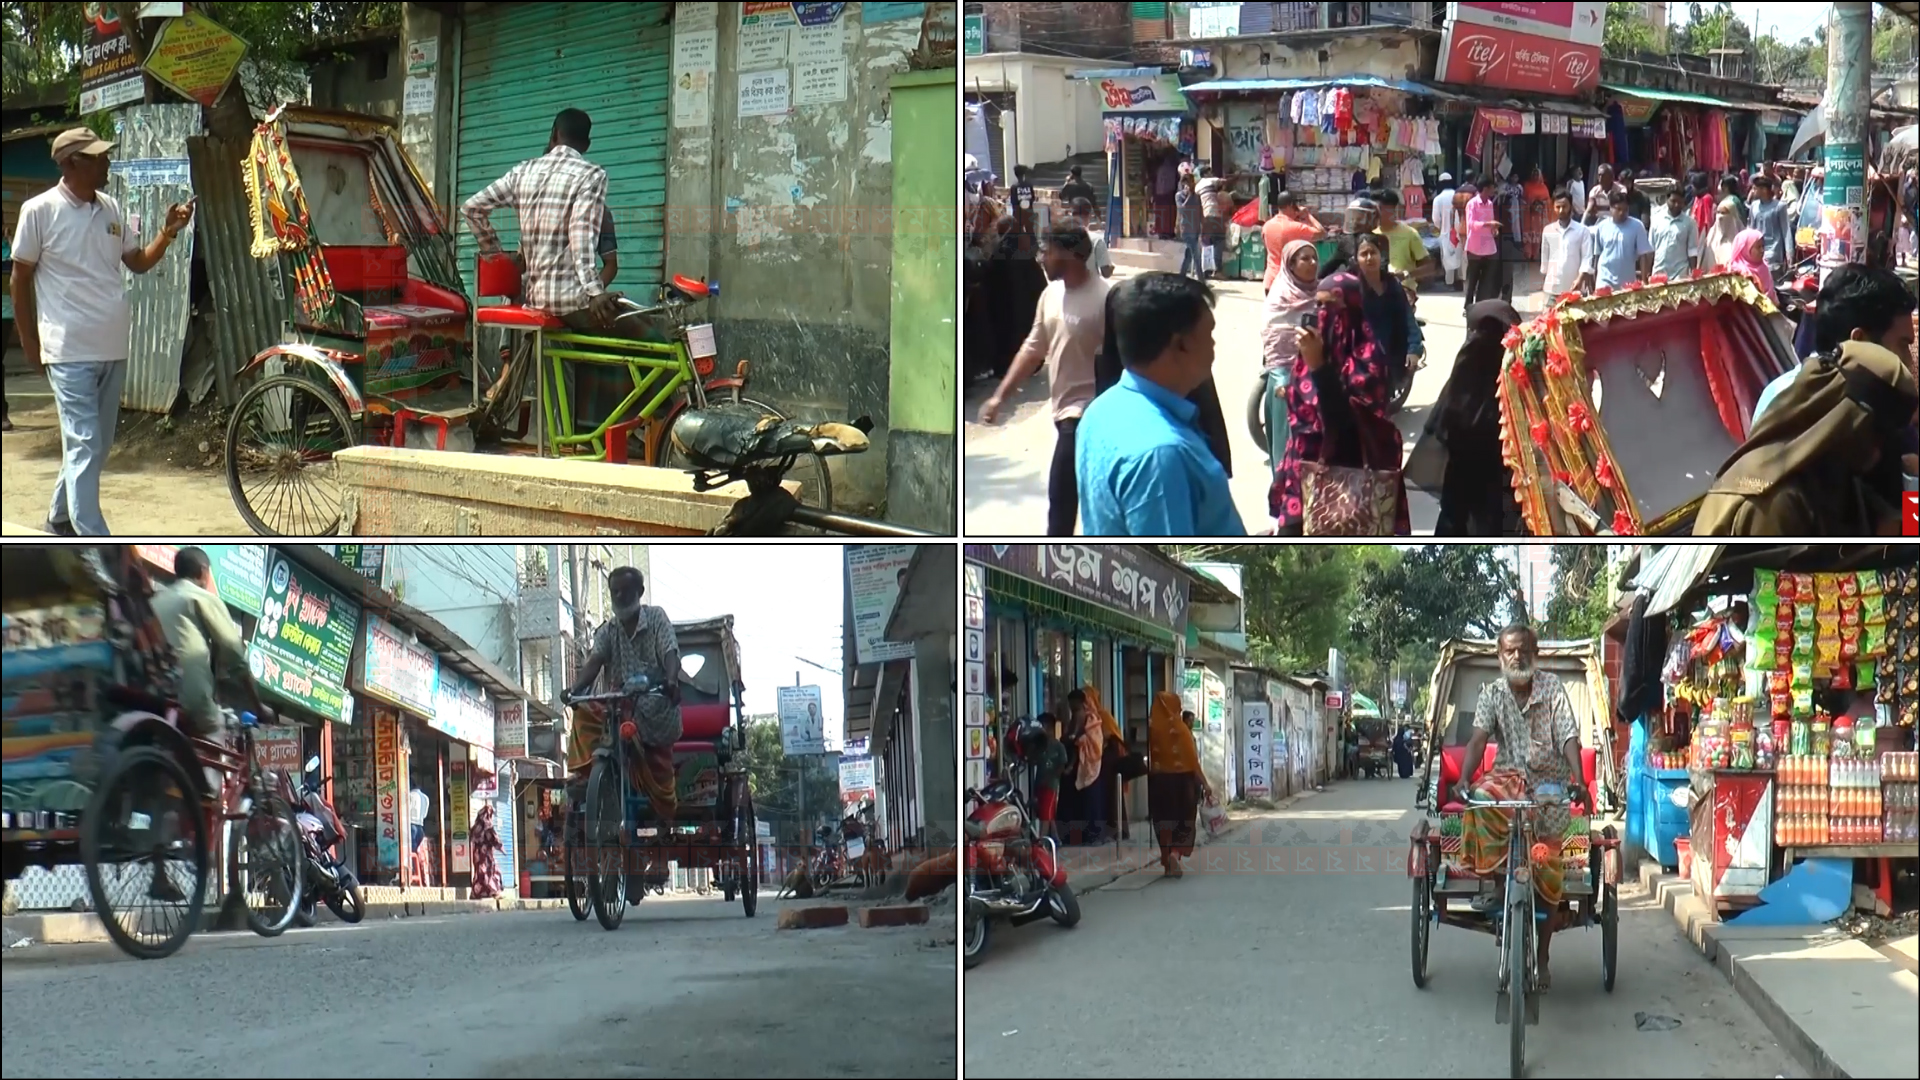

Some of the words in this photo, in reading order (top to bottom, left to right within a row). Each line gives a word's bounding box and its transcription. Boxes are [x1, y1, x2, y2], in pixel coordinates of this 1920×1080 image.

[1467, 40, 1497, 61] itel
[1565, 57, 1589, 75] itel
[1110, 559, 1158, 618] শপ
